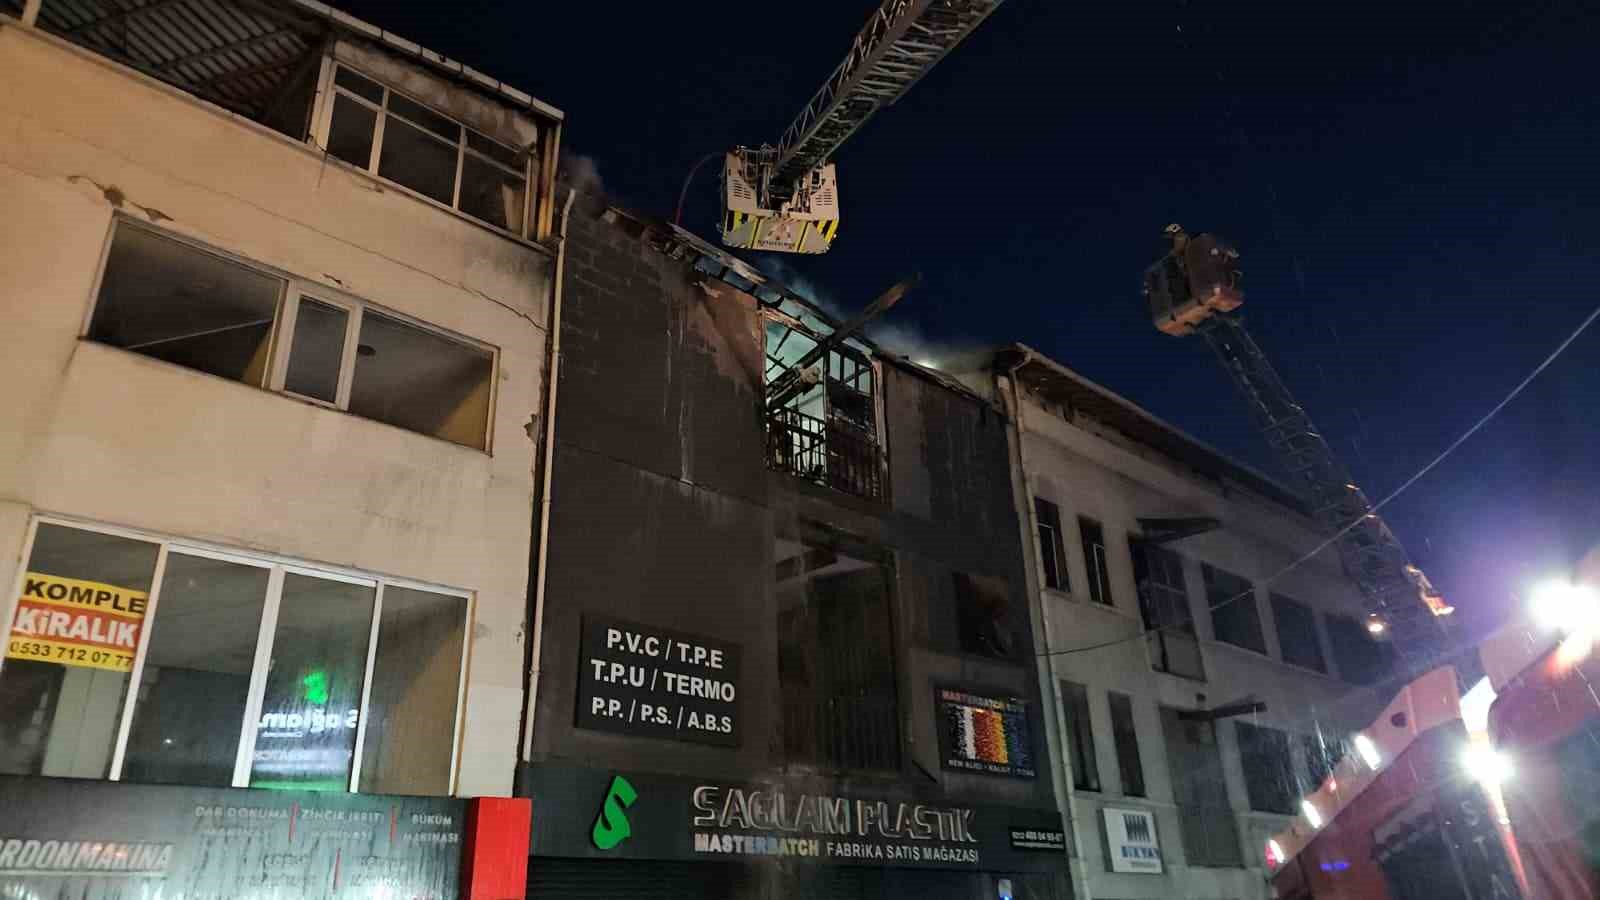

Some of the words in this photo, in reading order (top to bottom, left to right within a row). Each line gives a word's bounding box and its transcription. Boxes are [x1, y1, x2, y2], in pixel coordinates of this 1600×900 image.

[24, 579, 146, 614] KOMPLE
[9, 641, 51, 657] 0533
[56, 647, 87, 661] 712
[92, 651, 110, 664] 07
[115, 655, 134, 668] 77
[607, 628, 660, 657] P.V.C
[677, 642, 723, 669] T.P.E
[591, 659, 645, 688] T.P.U
[663, 672, 735, 702] TERMO
[591, 696, 624, 719] P.P.
[640, 704, 672, 725] P.S.
[688, 711, 732, 733] A.B.S
[693, 832, 819, 857] MASTERBATCH
[887, 845, 921, 861] SATIŞ
[924, 847, 979, 866] MAĞAZASI
